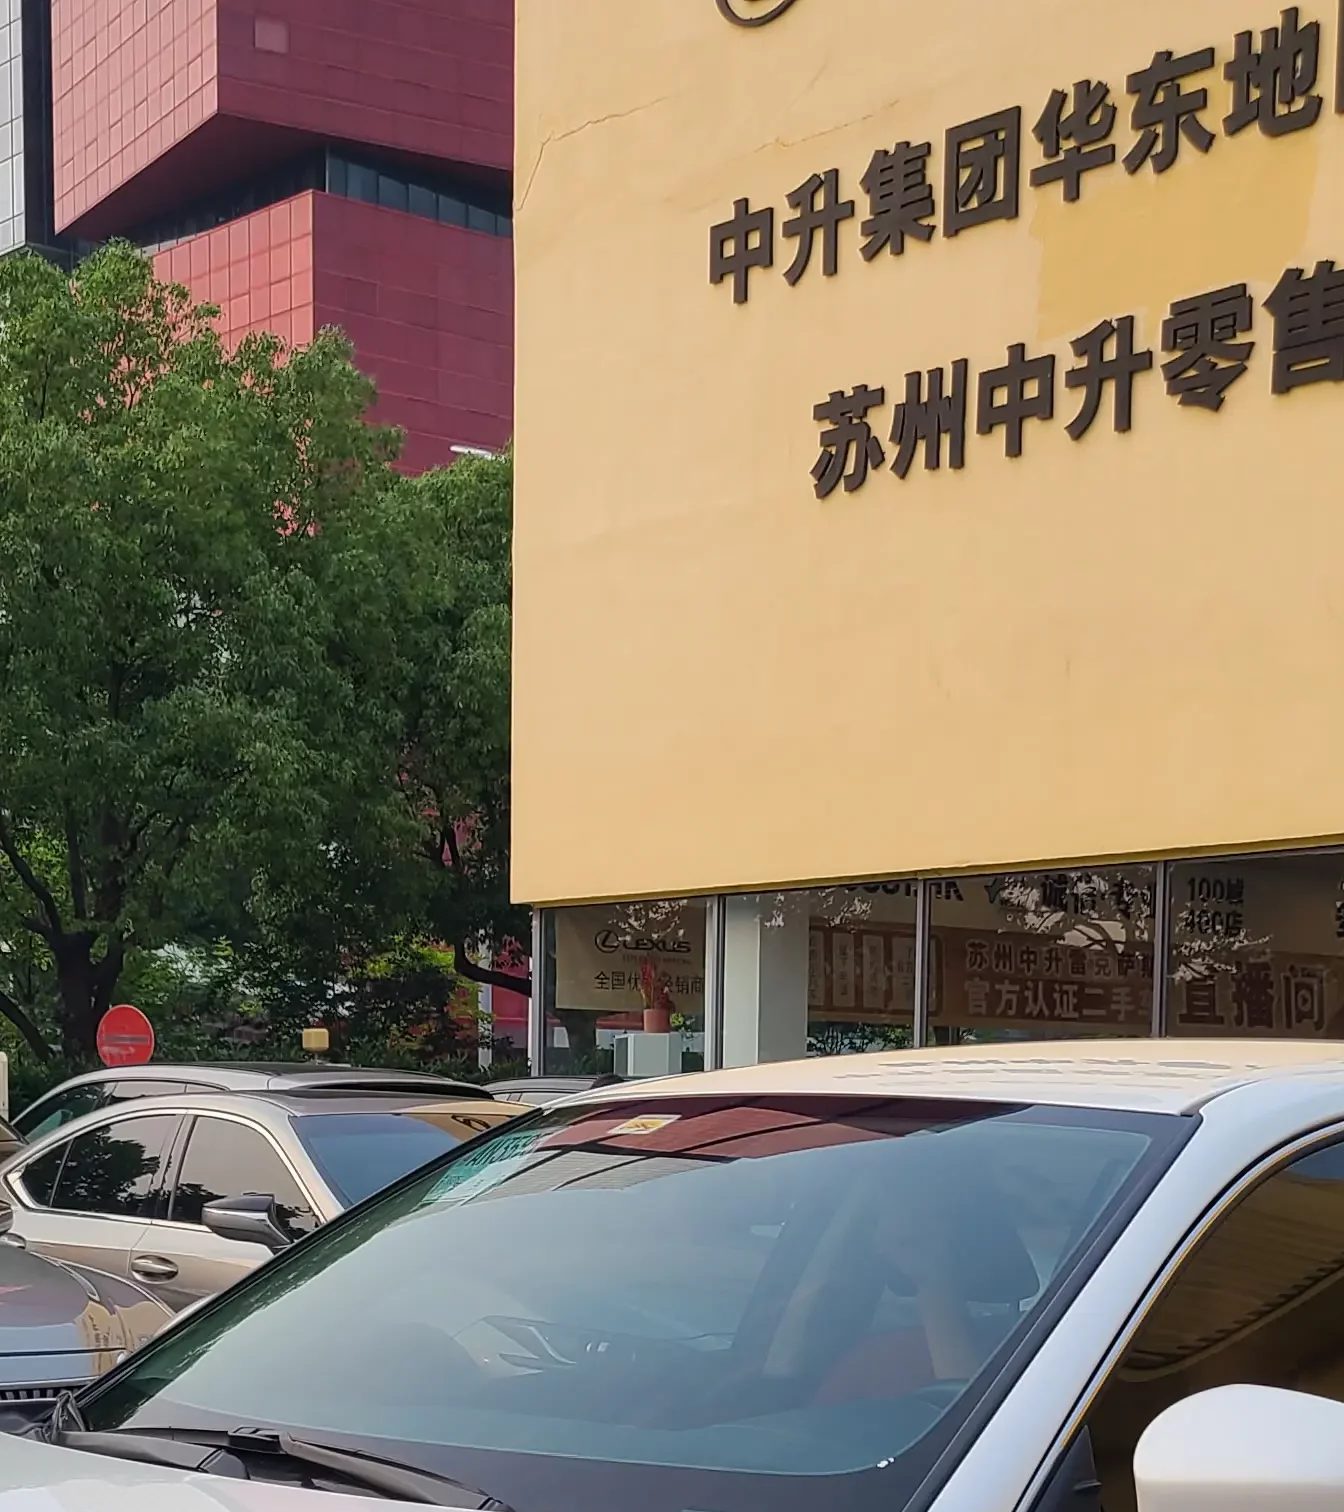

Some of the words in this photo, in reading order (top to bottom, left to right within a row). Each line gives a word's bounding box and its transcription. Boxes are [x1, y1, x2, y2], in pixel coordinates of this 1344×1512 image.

[622, 937, 692, 954] LEXUS
[594, 970, 705, 995] 全国优经销商
